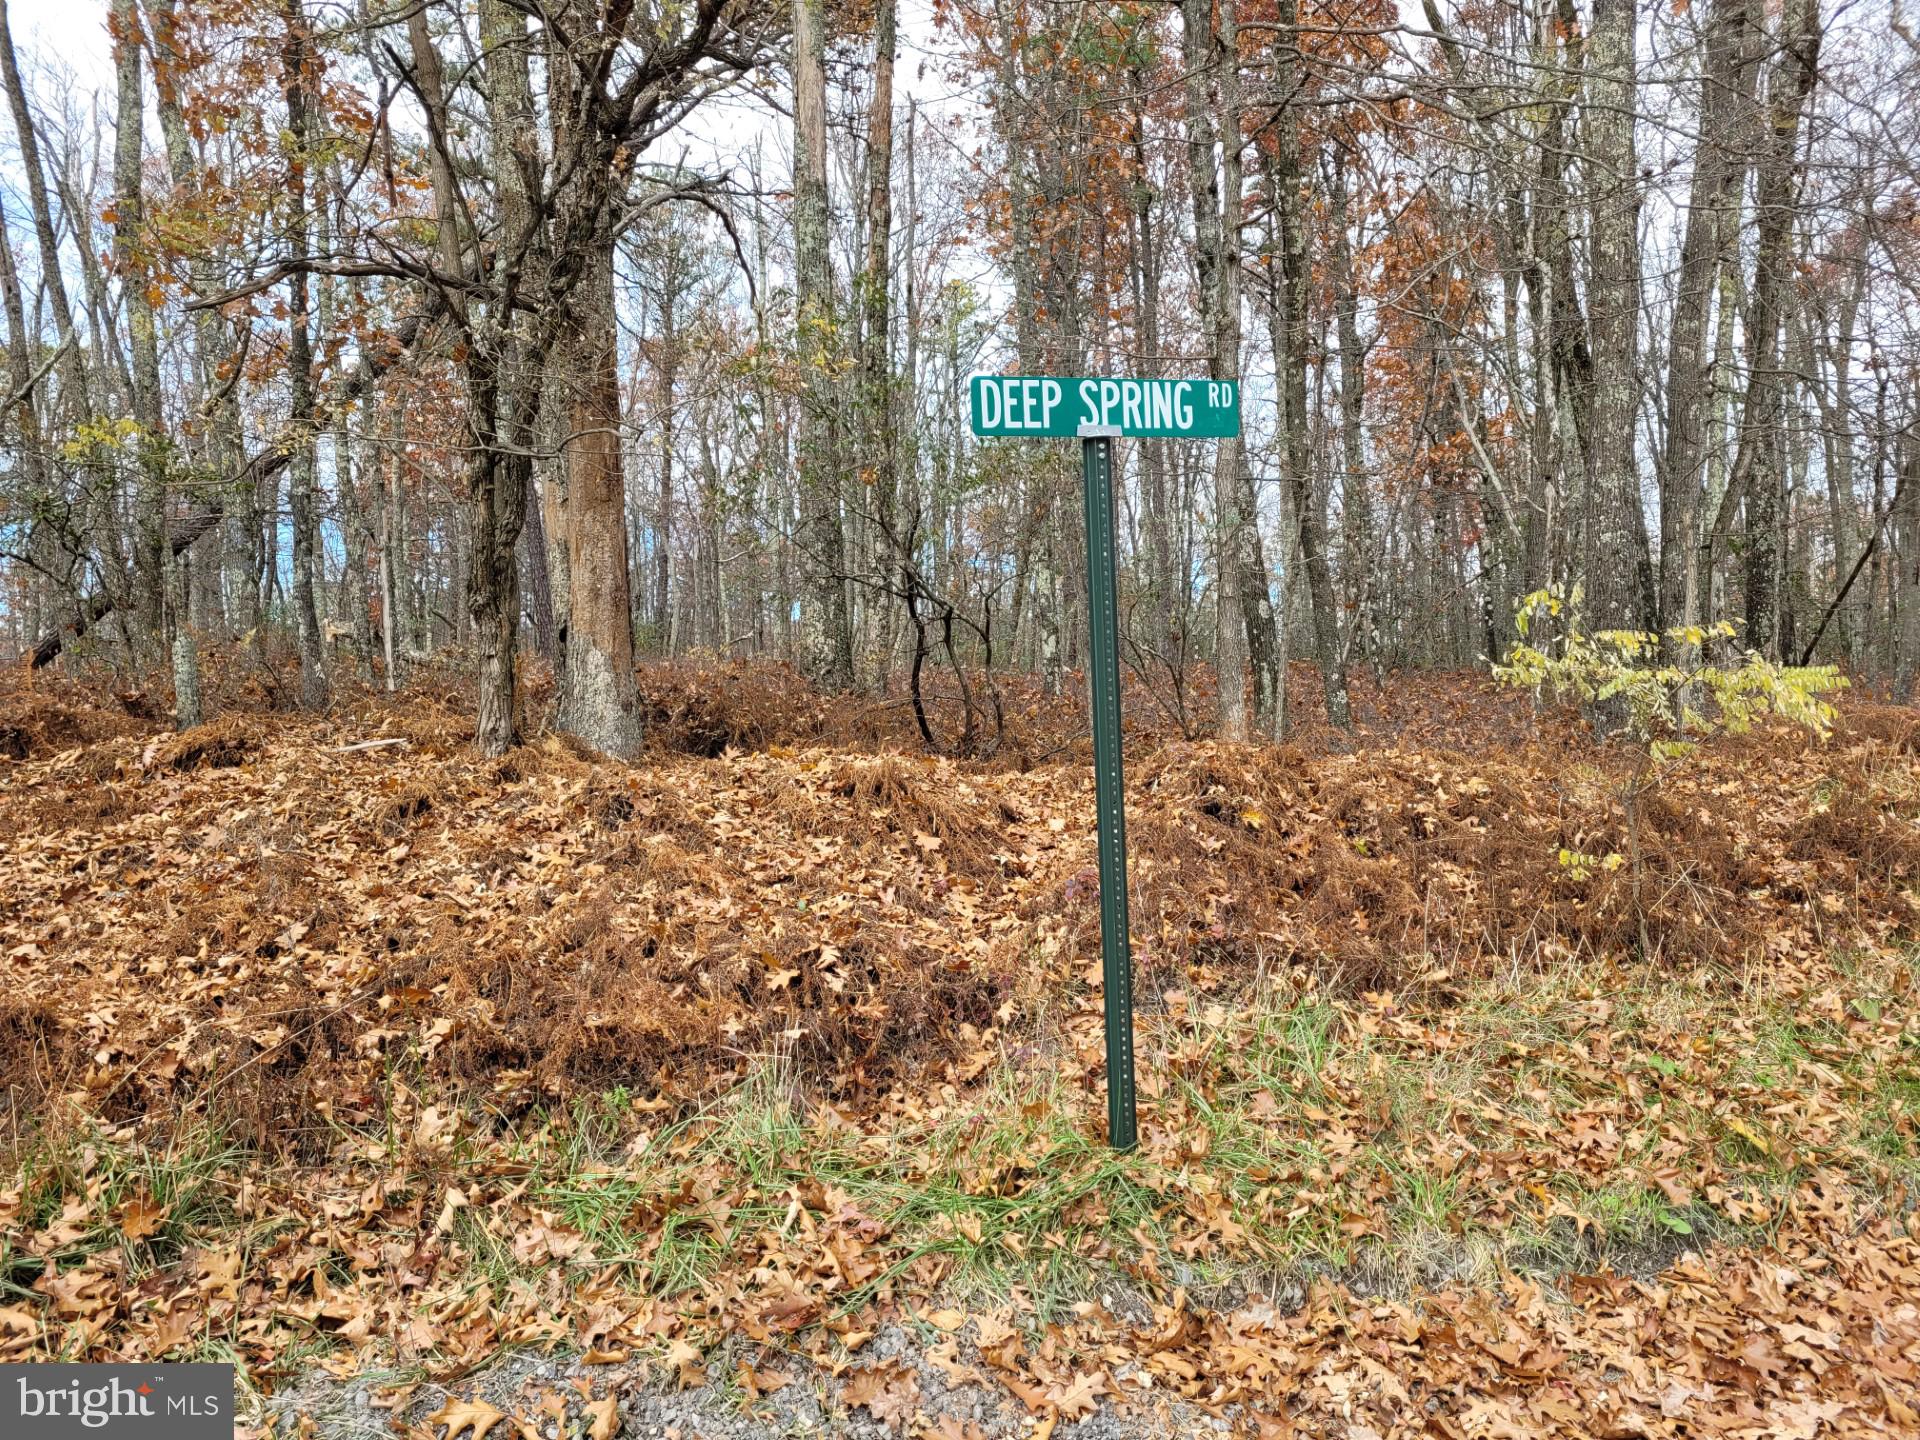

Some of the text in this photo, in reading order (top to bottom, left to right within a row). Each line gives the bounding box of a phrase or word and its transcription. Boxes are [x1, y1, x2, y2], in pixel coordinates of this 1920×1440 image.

[980, 380, 1233, 430] DEEP SPRING RD
